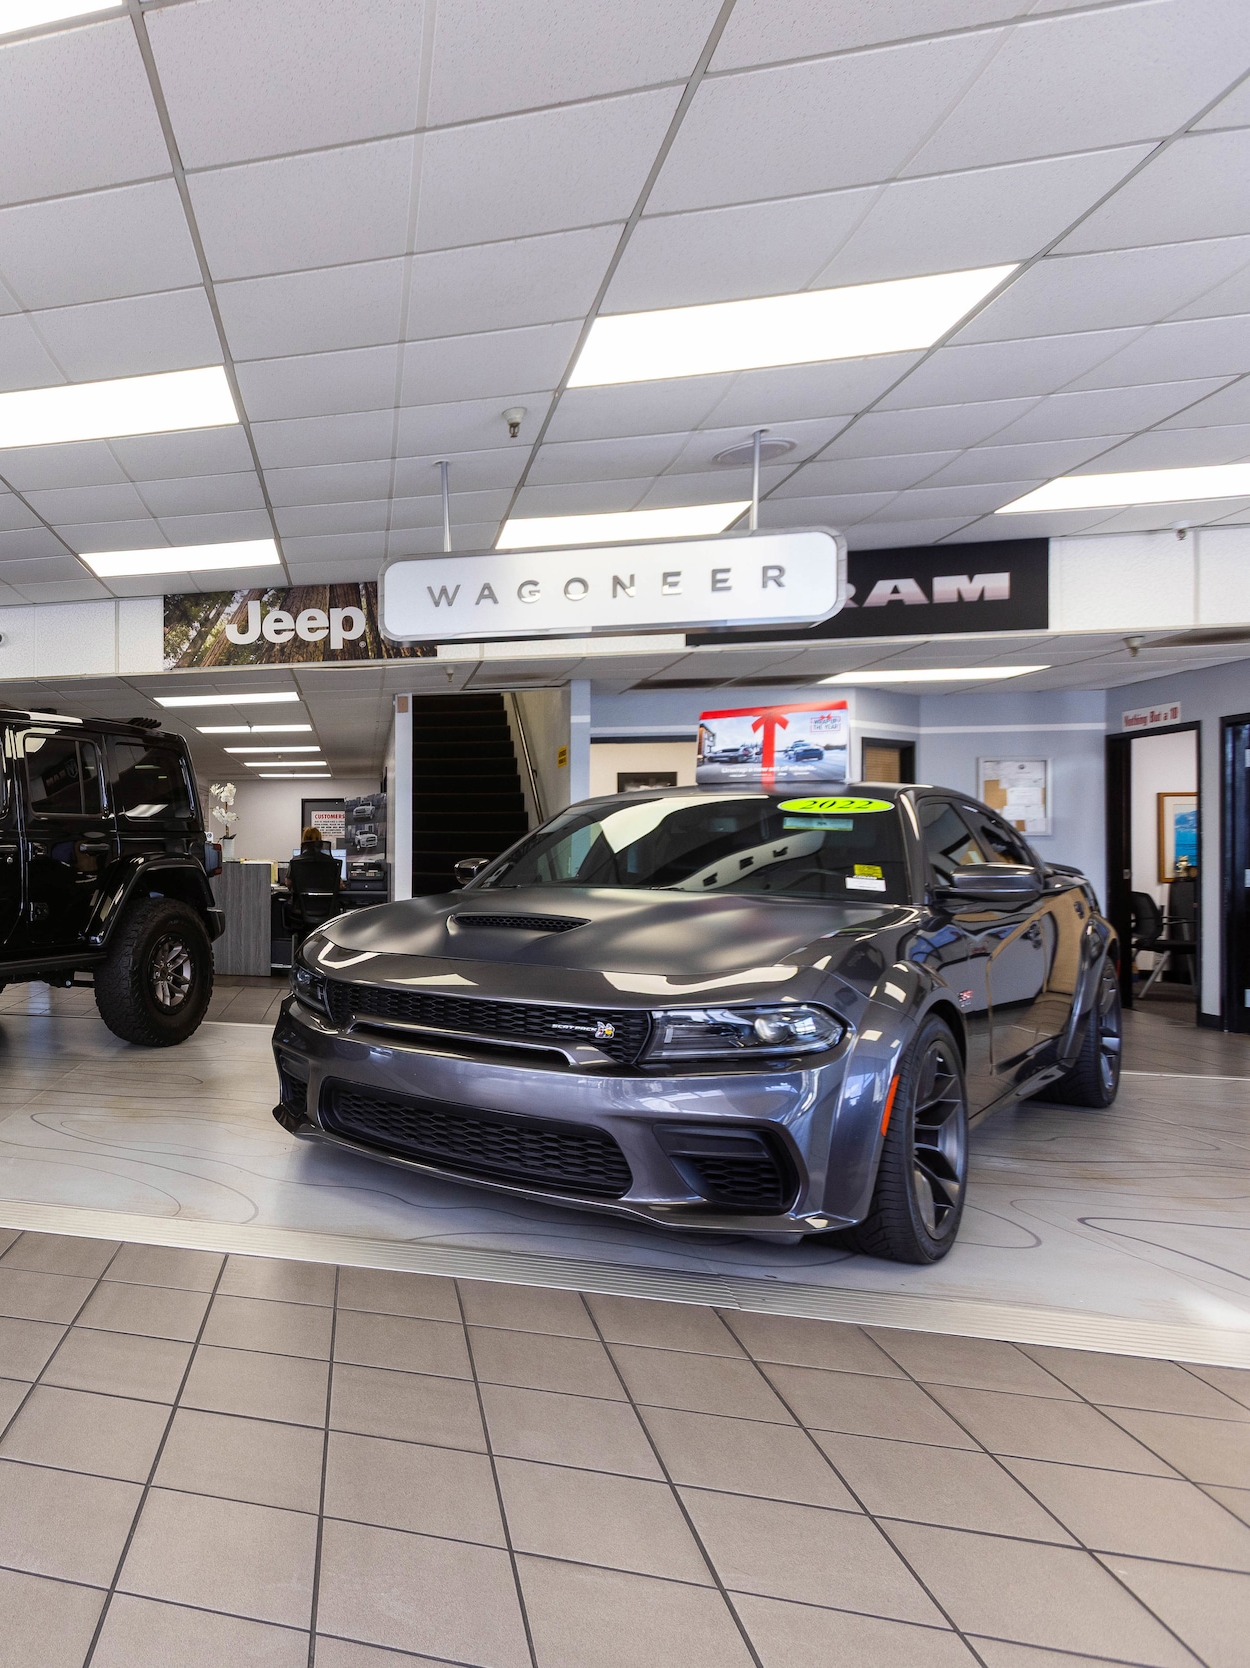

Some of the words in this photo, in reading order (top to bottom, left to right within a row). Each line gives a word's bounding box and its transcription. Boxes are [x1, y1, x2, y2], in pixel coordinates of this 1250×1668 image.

[427, 565, 785, 607] WAGONEER
[225, 600, 367, 650] Jeep
[1149, 710, 1161, 723] But
[799, 800, 873, 809] 2022
